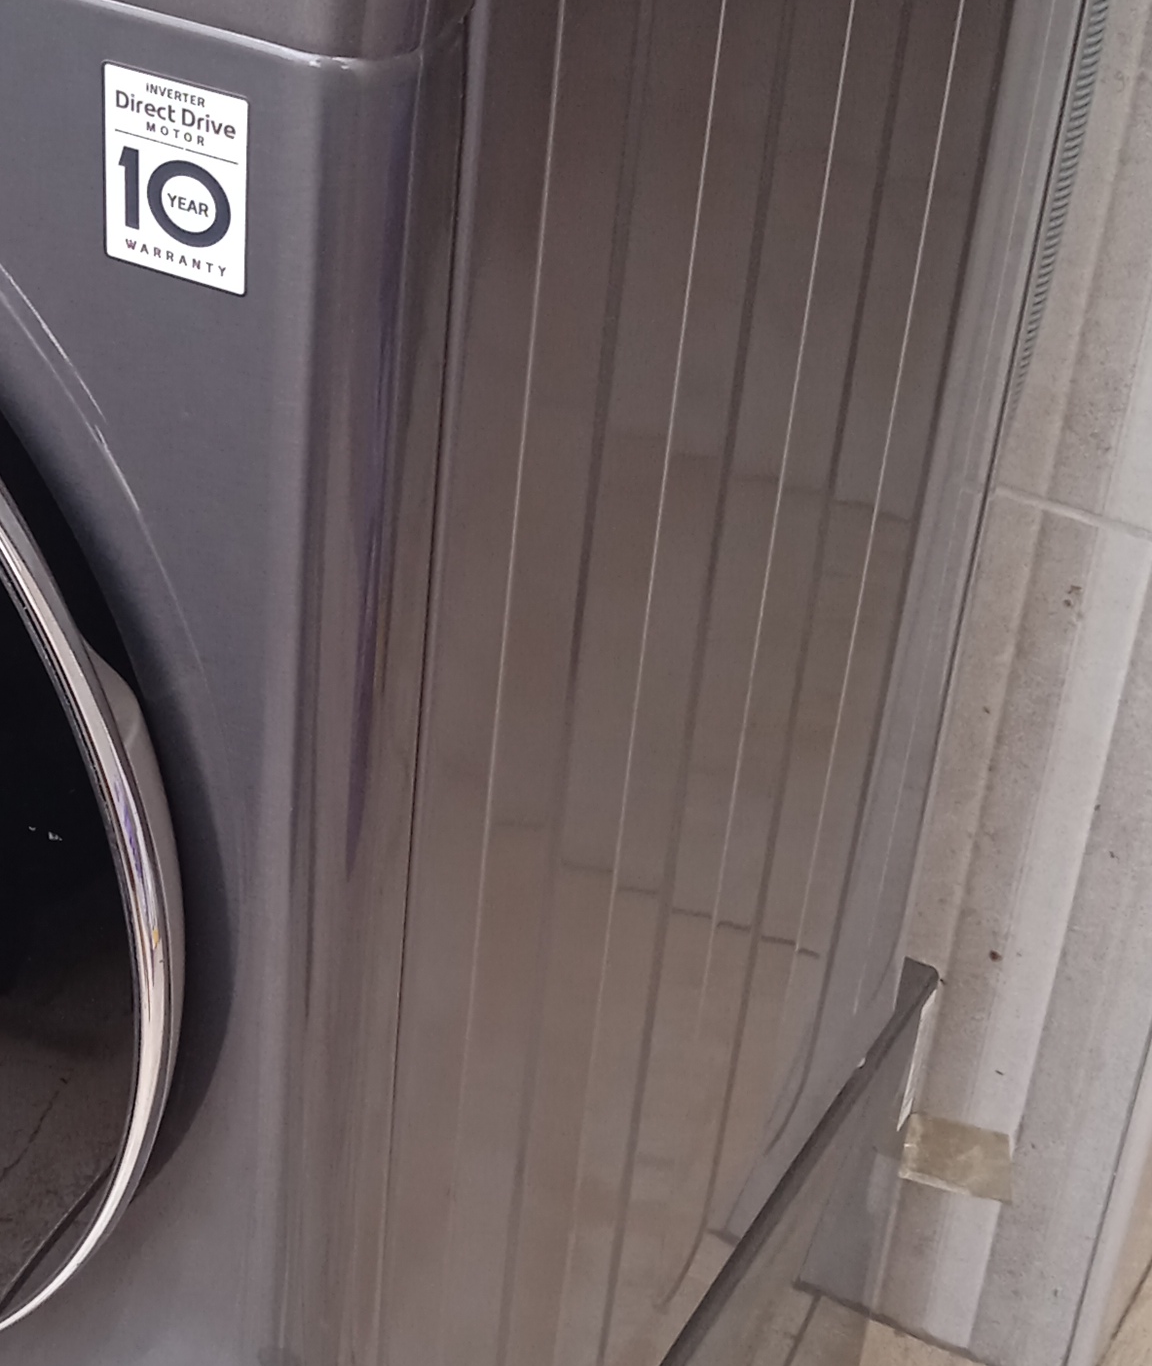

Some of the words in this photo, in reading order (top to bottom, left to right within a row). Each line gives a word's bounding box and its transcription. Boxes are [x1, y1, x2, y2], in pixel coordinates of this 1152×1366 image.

[115, 89, 176, 123] Direct
[181, 108, 237, 140] Drive
[146, 121, 205, 147] MOTOR
[118, 145, 232, 248] 10
[167, 192, 209, 218] YEAR
[125, 238, 227, 277] WARRANTY
